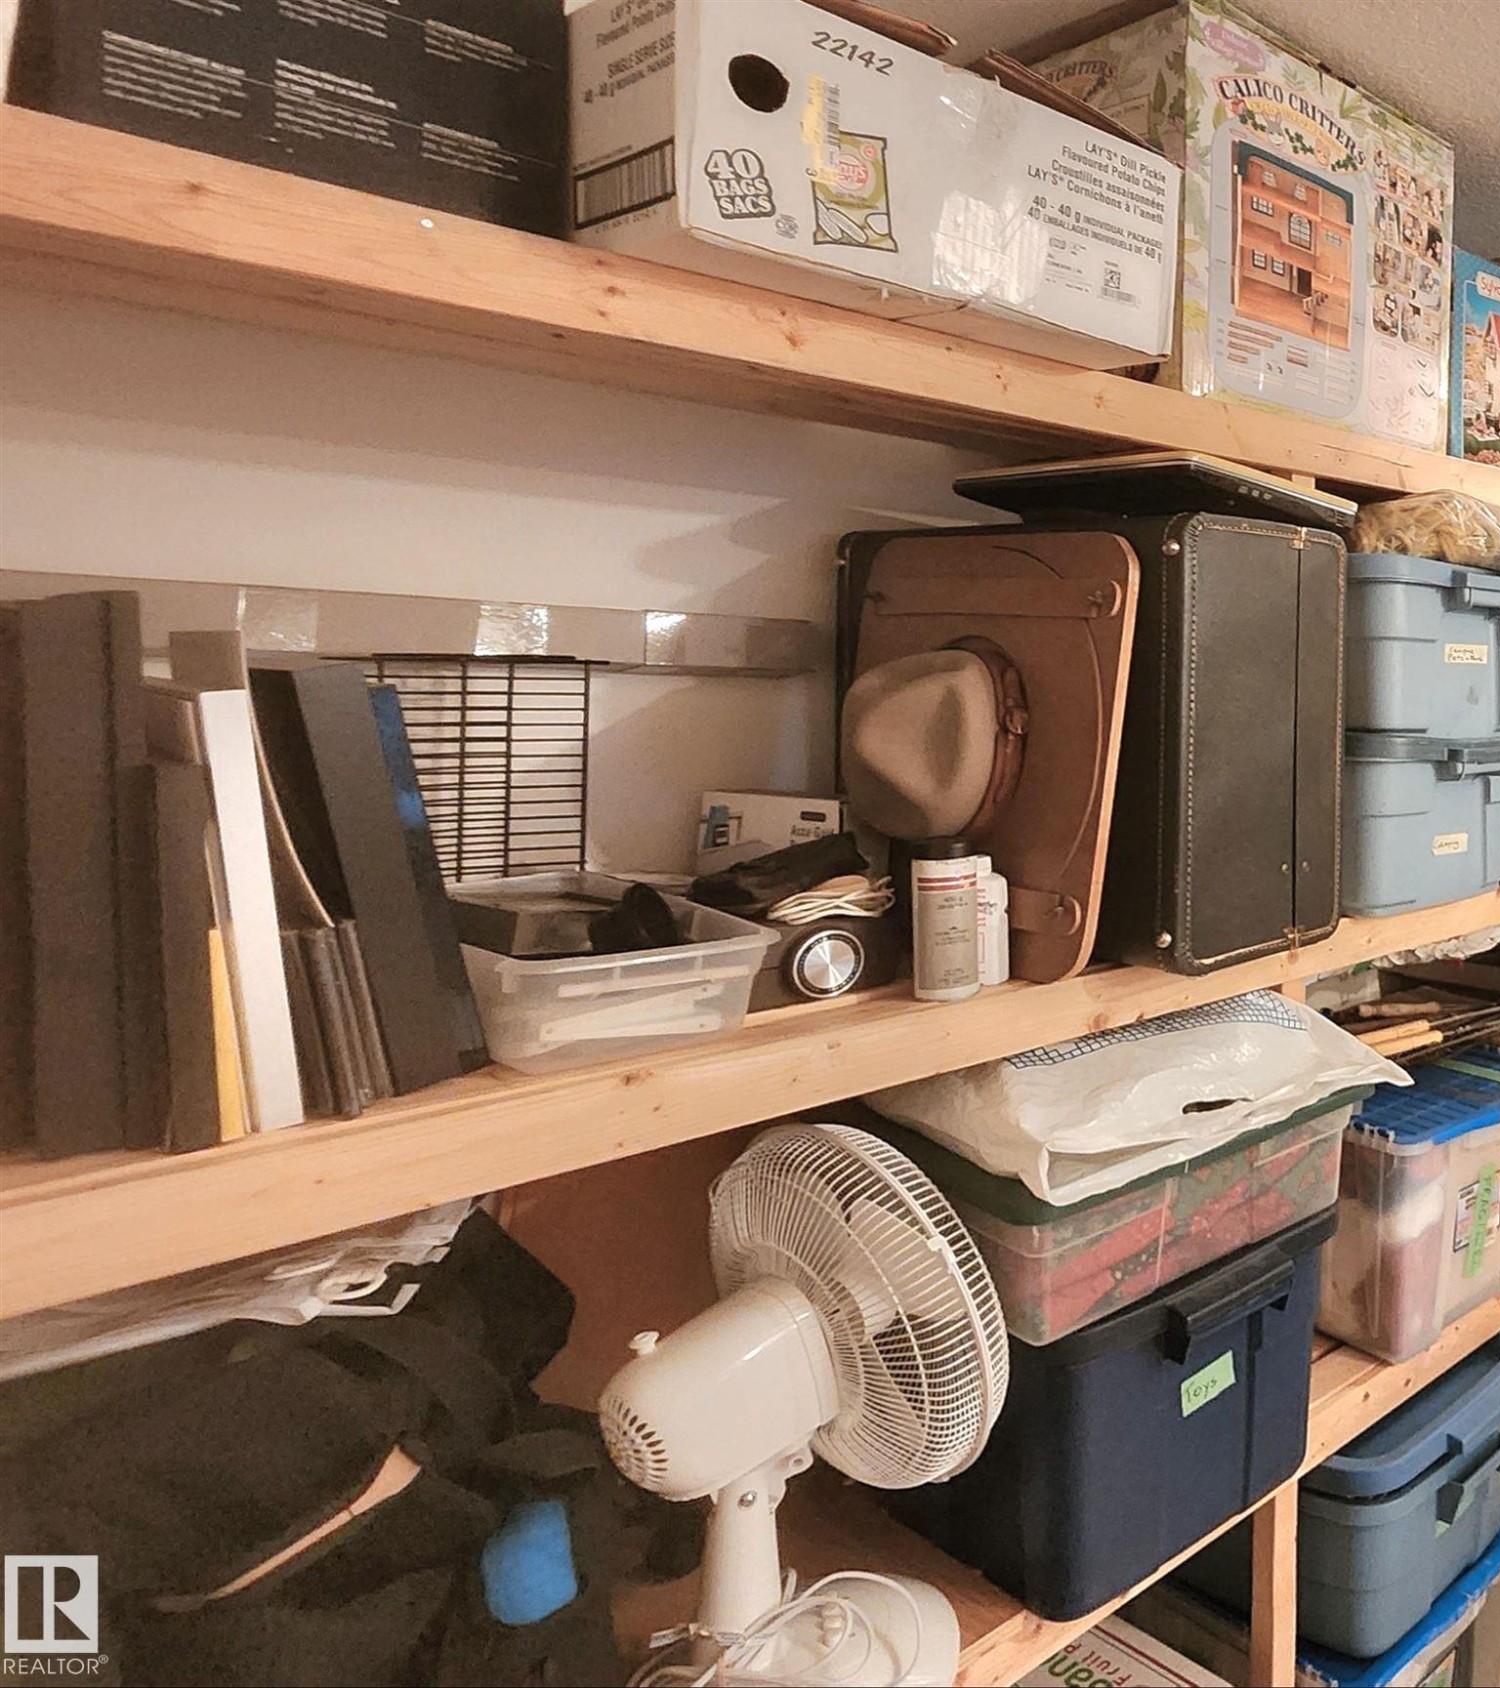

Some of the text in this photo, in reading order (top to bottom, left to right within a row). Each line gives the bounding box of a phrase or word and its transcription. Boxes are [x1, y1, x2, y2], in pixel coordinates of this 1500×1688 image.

[810, 30, 894, 76] 22142
[1219, 78, 1284, 104] CALICO
[1289, 93, 1366, 166] CRITTERS
[705, 149, 763, 179] 40
[1050, 158, 1104, 189] Croustilles
[1061, 144, 1167, 197] Flavoured Potato Chips
[1119, 155, 1138, 171] Dill
[1139, 162, 1167, 184] Pickle
[713, 176, 772, 197] BAGS
[1066, 179, 1122, 210] Cornichons
[718, 195, 775, 216] SACS
[1026, 205, 1041, 221] 40
[1032, 194, 1048, 210] 40
[1057, 203, 1072, 219] 40
[1074, 210, 1082, 225] g
[1185, 1380, 1218, 1404] Toys
